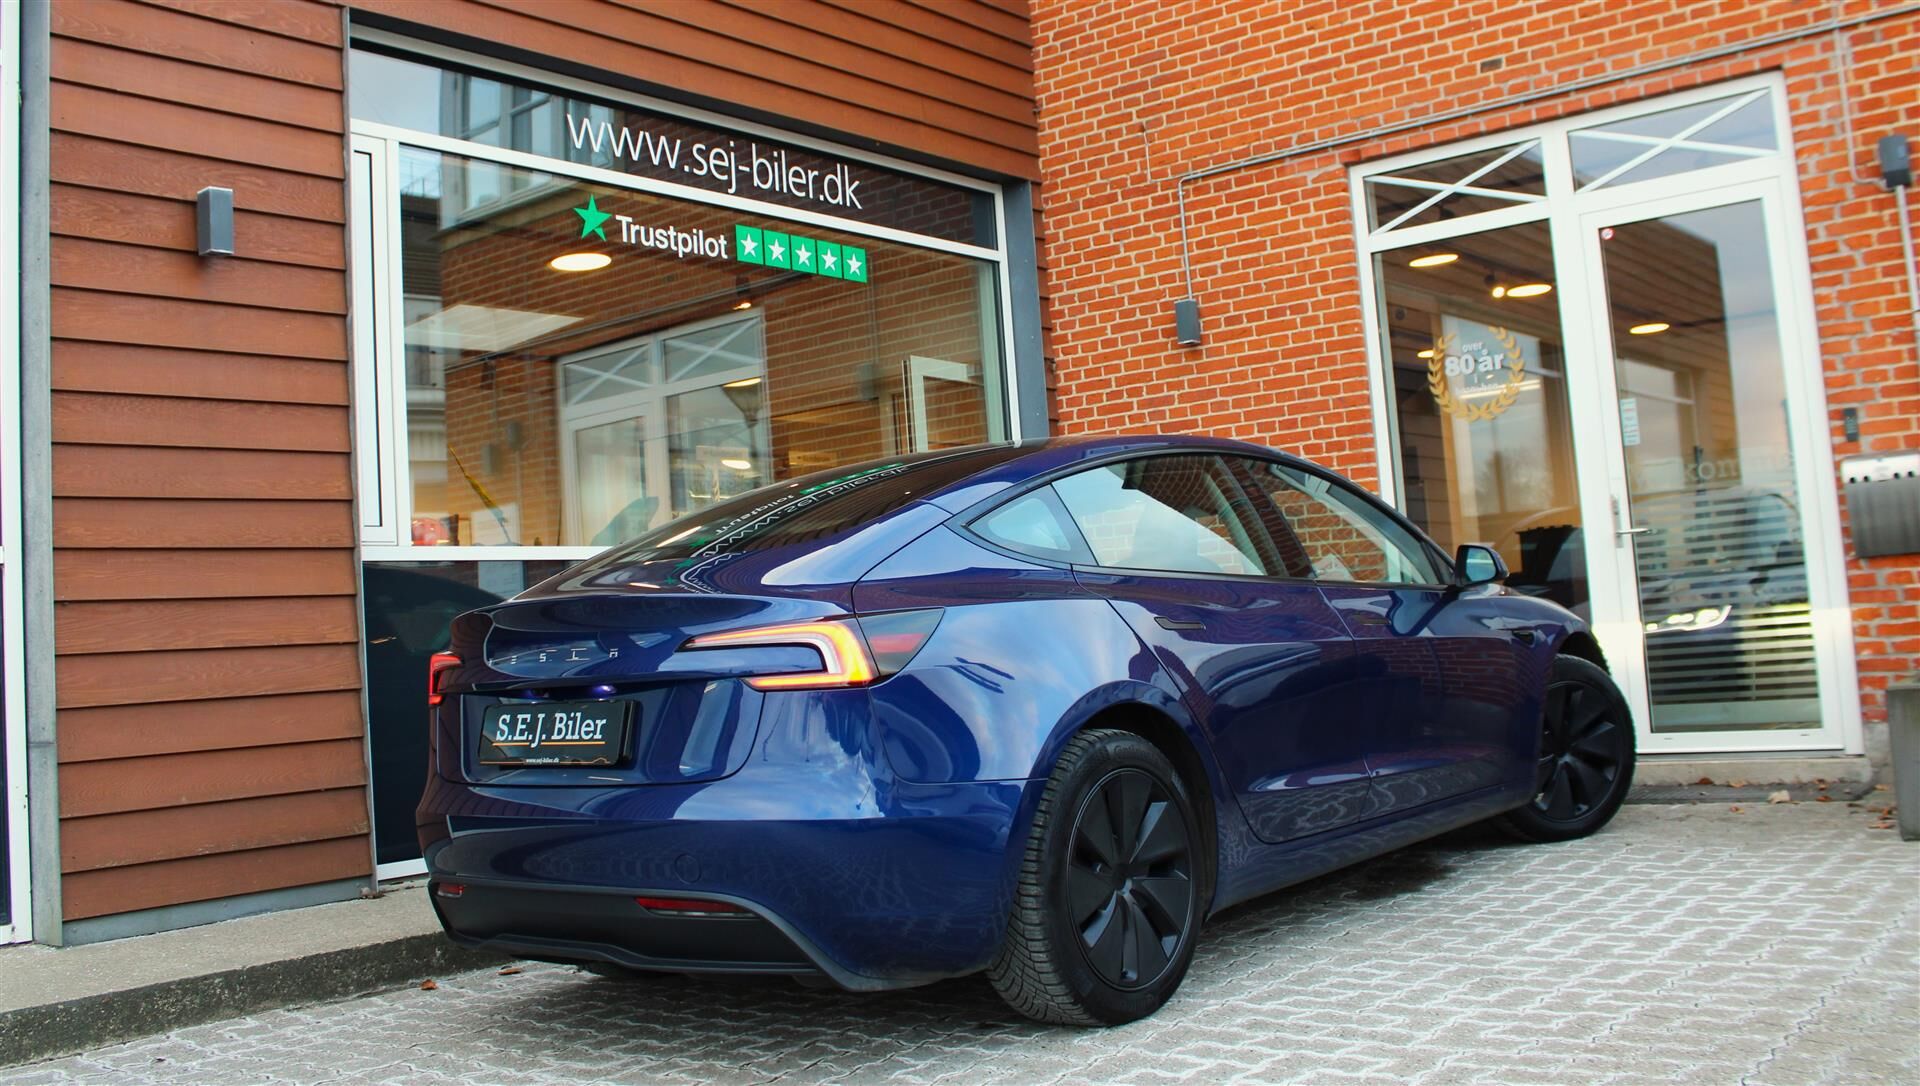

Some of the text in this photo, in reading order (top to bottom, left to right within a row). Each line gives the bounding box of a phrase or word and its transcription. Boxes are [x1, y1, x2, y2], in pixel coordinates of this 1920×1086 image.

[566, 113, 862, 210] www.sej-biler.dk
[615, 214, 728, 259] Trustpilot
[1445, 348, 1504, 376] 80 år
[1462, 341, 1483, 353] over
[496, 711, 607, 748] S.E.J. Biler
